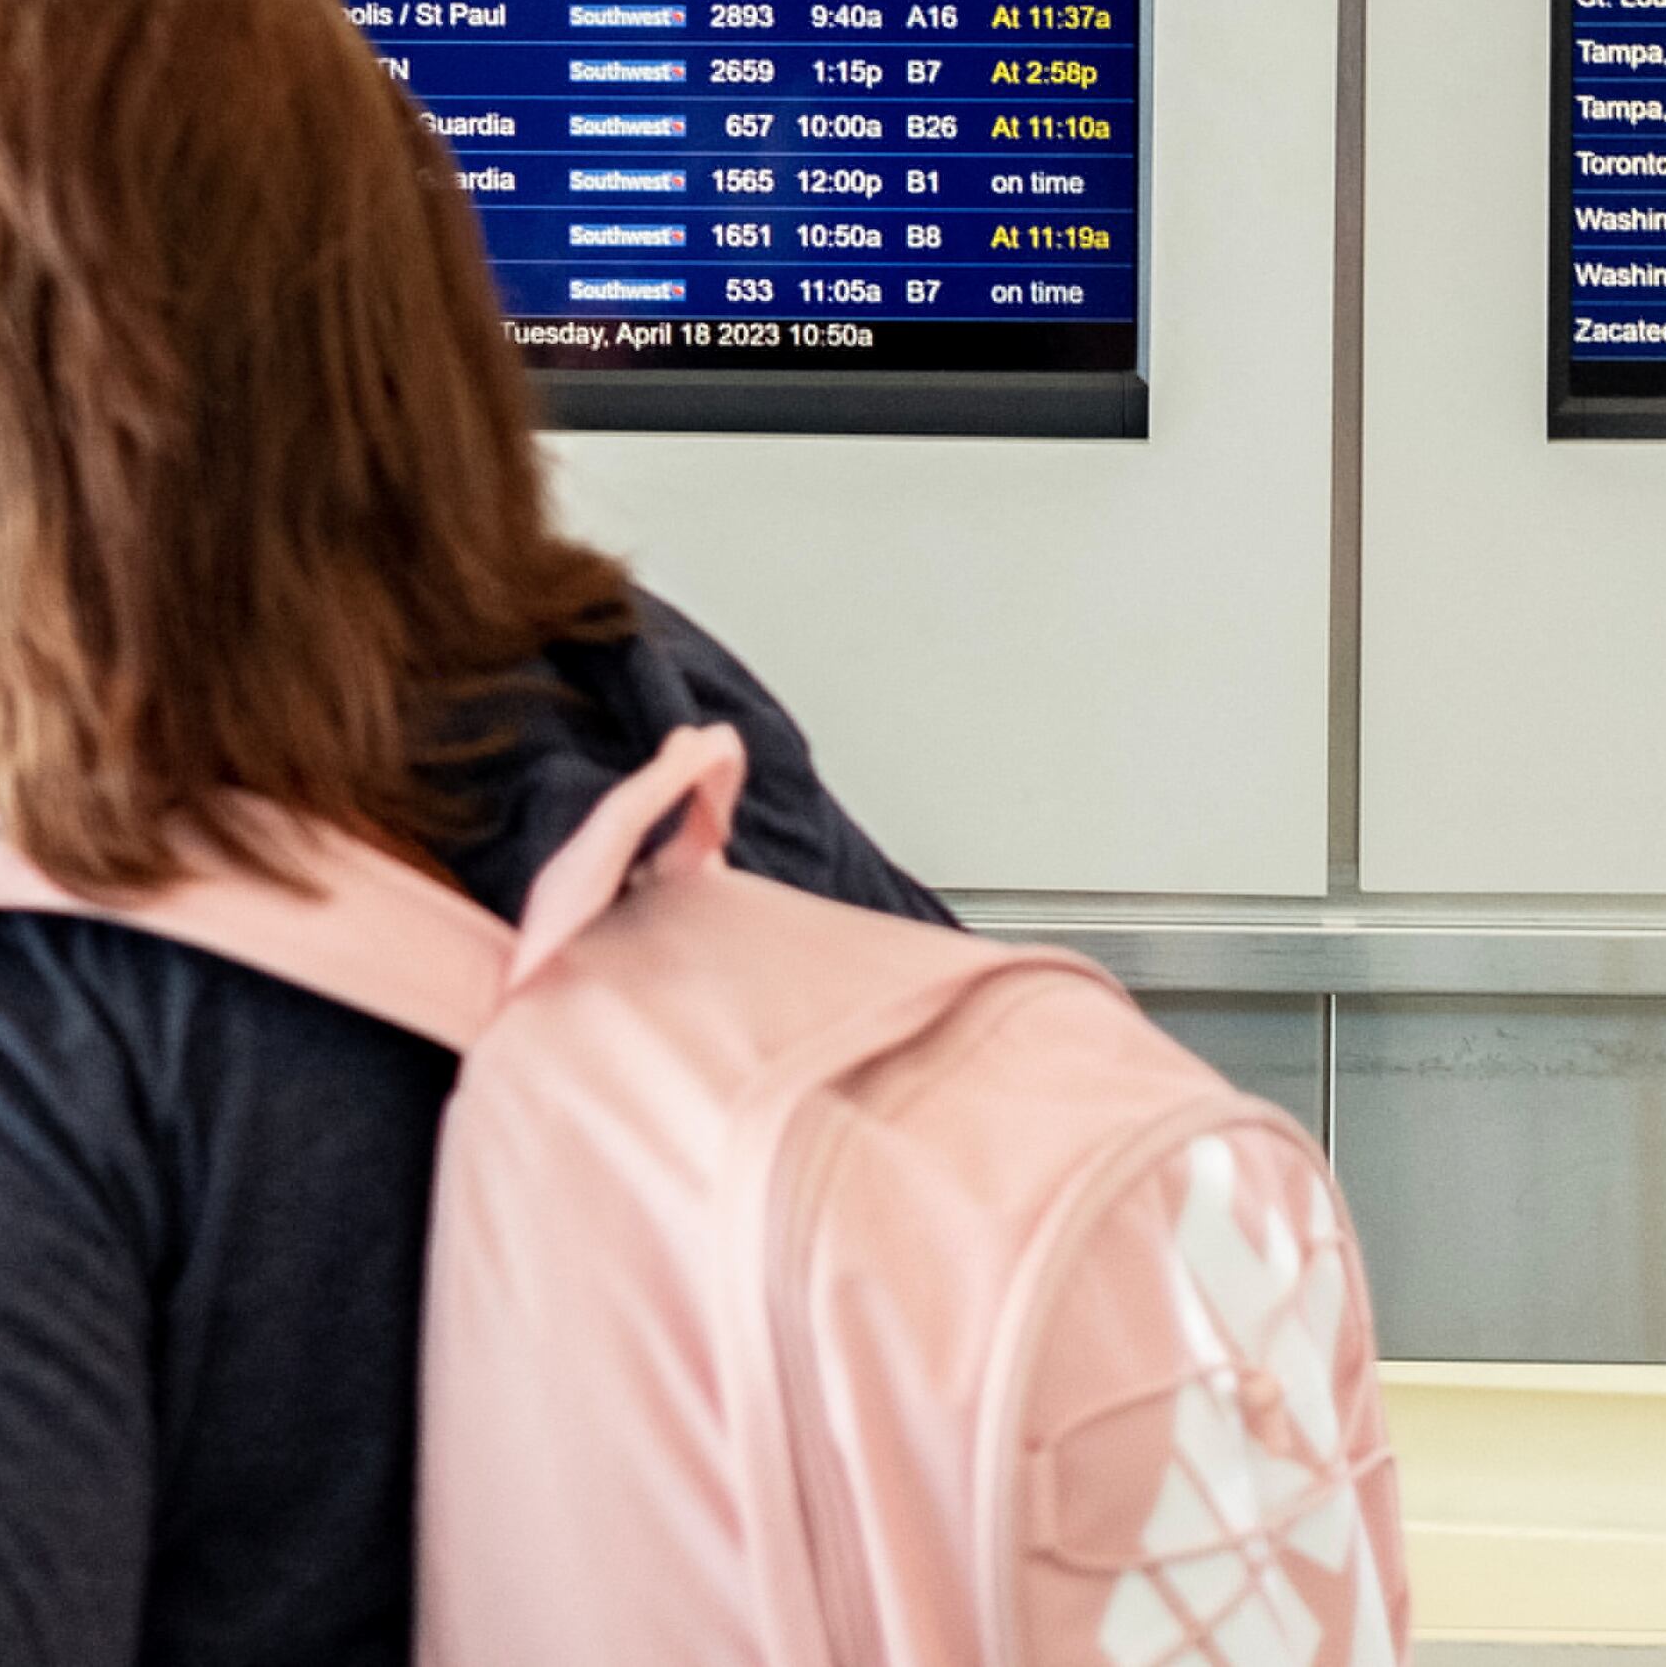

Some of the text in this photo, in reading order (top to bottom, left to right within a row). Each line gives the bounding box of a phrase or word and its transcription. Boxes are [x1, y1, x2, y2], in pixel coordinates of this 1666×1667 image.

[570, 223, 1110, 249] Southwest 1651 10:50a B8 At 11:19a
